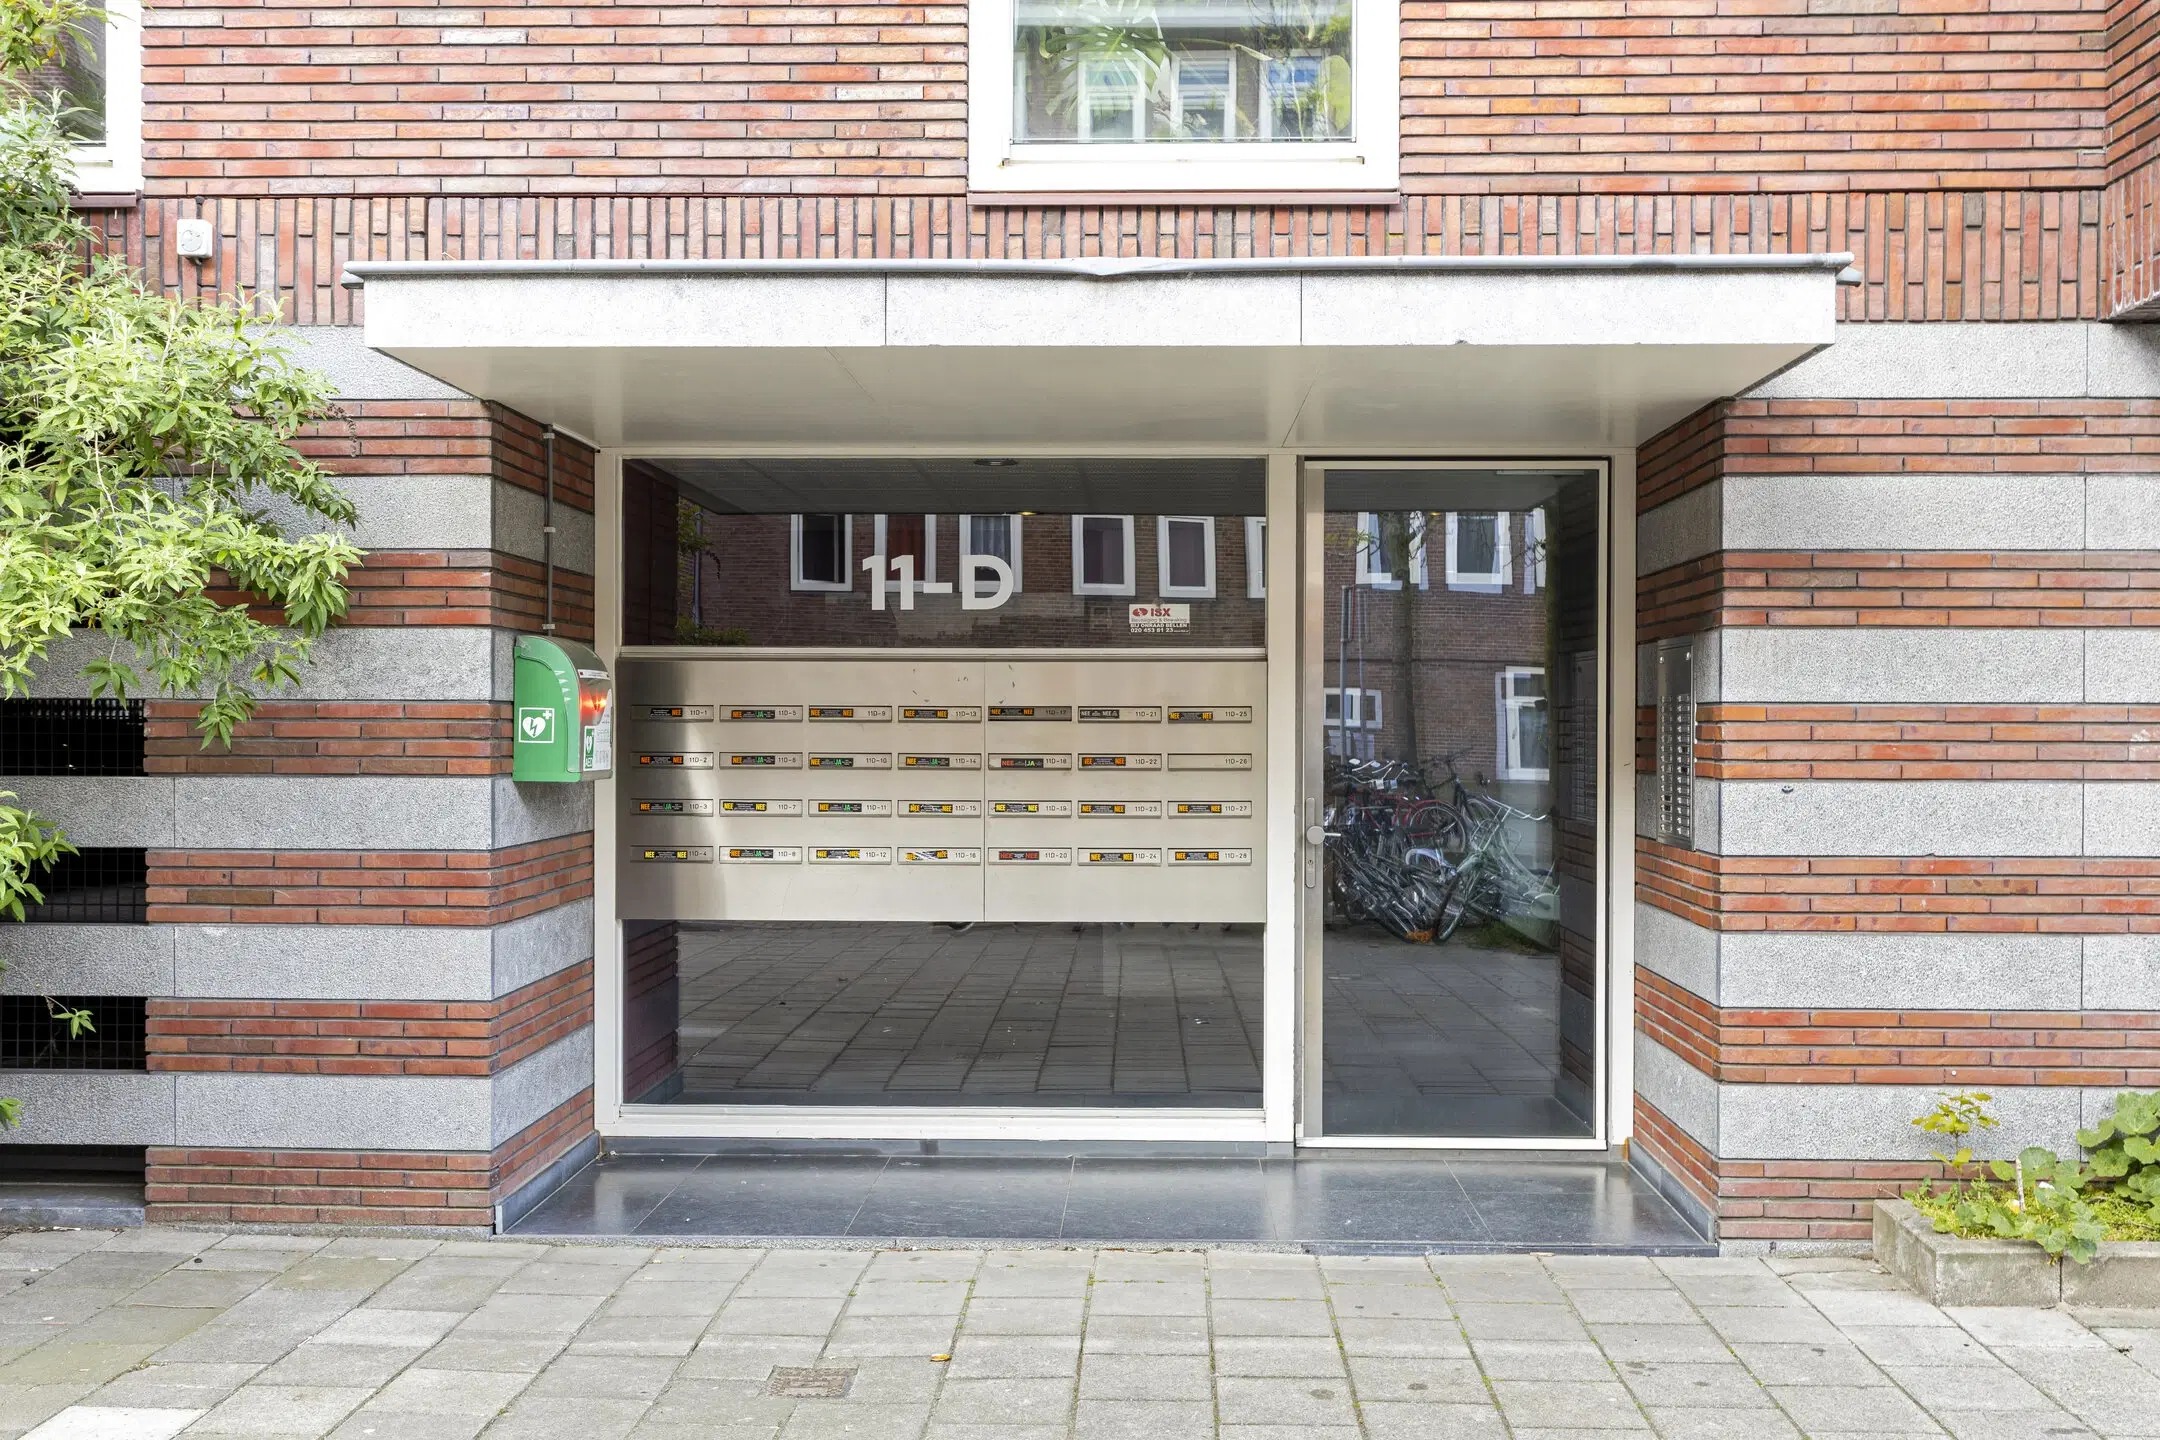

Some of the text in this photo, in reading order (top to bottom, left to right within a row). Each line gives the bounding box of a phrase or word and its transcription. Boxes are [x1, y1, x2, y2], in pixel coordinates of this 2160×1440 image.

[862, 554, 1014, 611] 11-D
[1151, 608, 1171, 617] ISX
[843, 709, 853, 717] NEE
[640, 756, 650, 764] NEE
[672, 756, 683, 764] NEE
[732, 756, 742, 764] NEE
[810, 758, 821, 766] NEE
[834, 758, 842, 766] JA
[1083, 757, 1092, 765] NEE
[1115, 757, 1125, 765] NEE
[640, 803, 650, 811] NEE
[723, 802, 734, 810] NEE
[756, 803, 766, 811] NEE
[819, 803, 829, 811] NEE
[843, 803, 851, 811] JA
[645, 851, 655, 859] NEE
[677, 851, 687, 859] NEE
[1176, 852, 1186, 860] NEE
[1208, 852, 1218, 860] NEE
